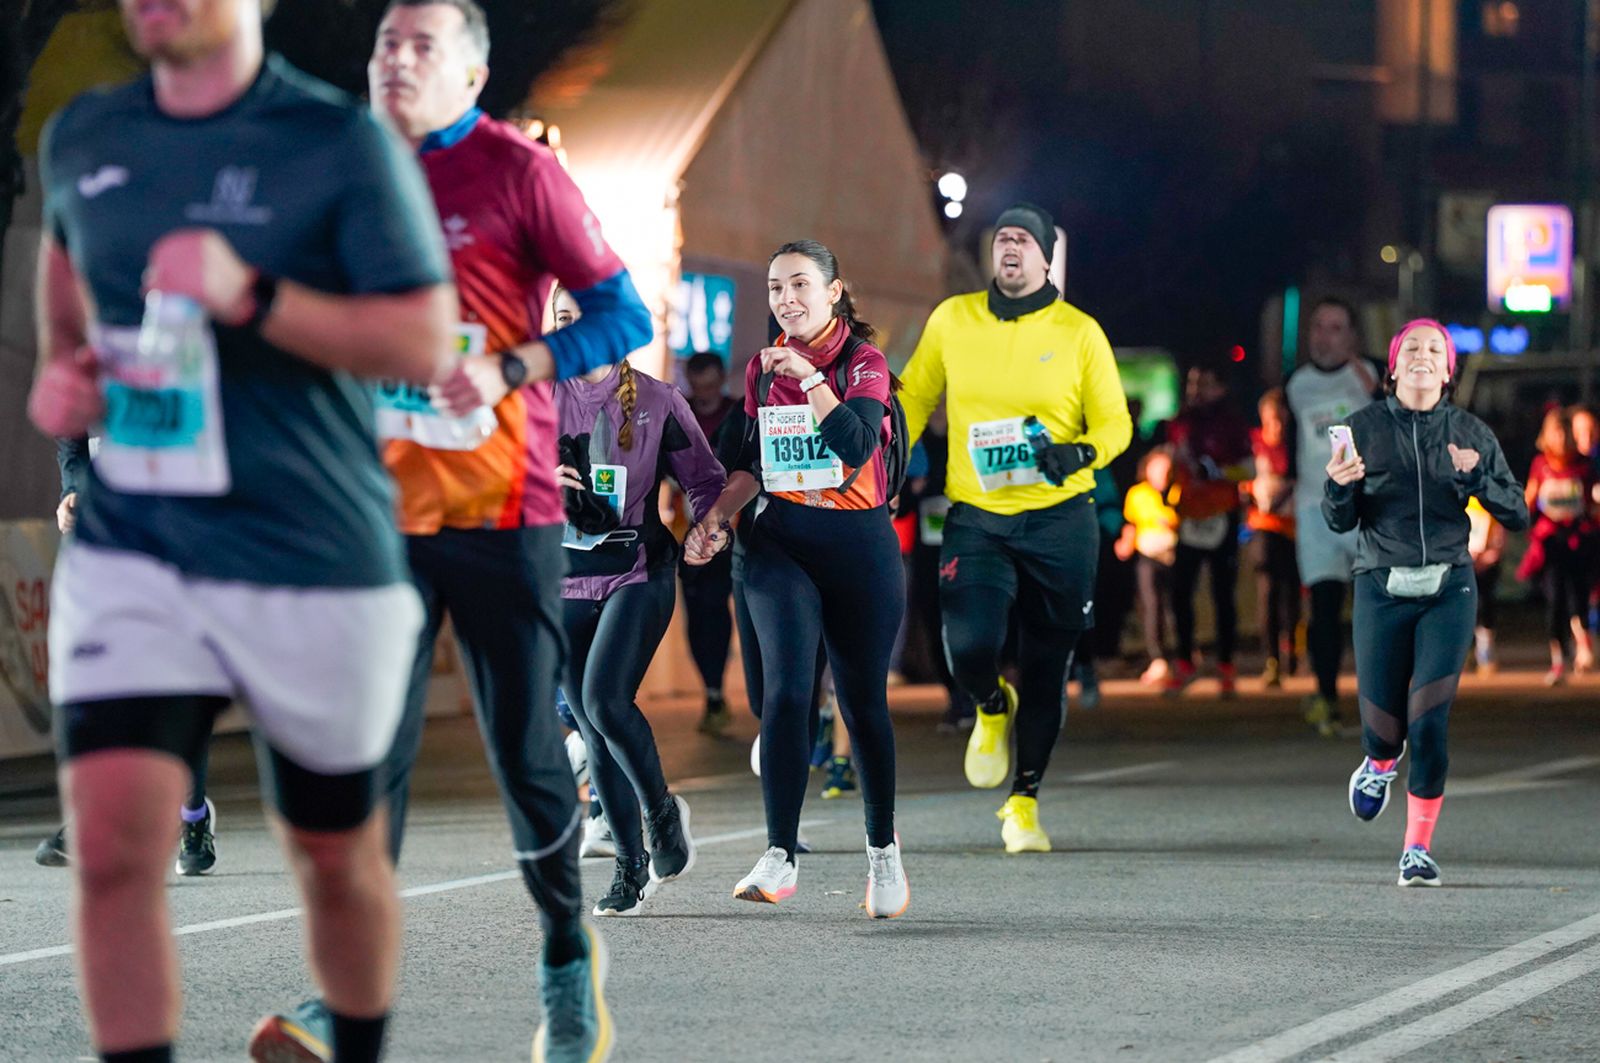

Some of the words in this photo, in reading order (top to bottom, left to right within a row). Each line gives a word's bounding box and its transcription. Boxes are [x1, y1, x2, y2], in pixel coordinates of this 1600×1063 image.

[768, 426, 782, 436] SAN
[772, 436, 829, 462] 13912
[984, 443, 1029, 467] 7726
